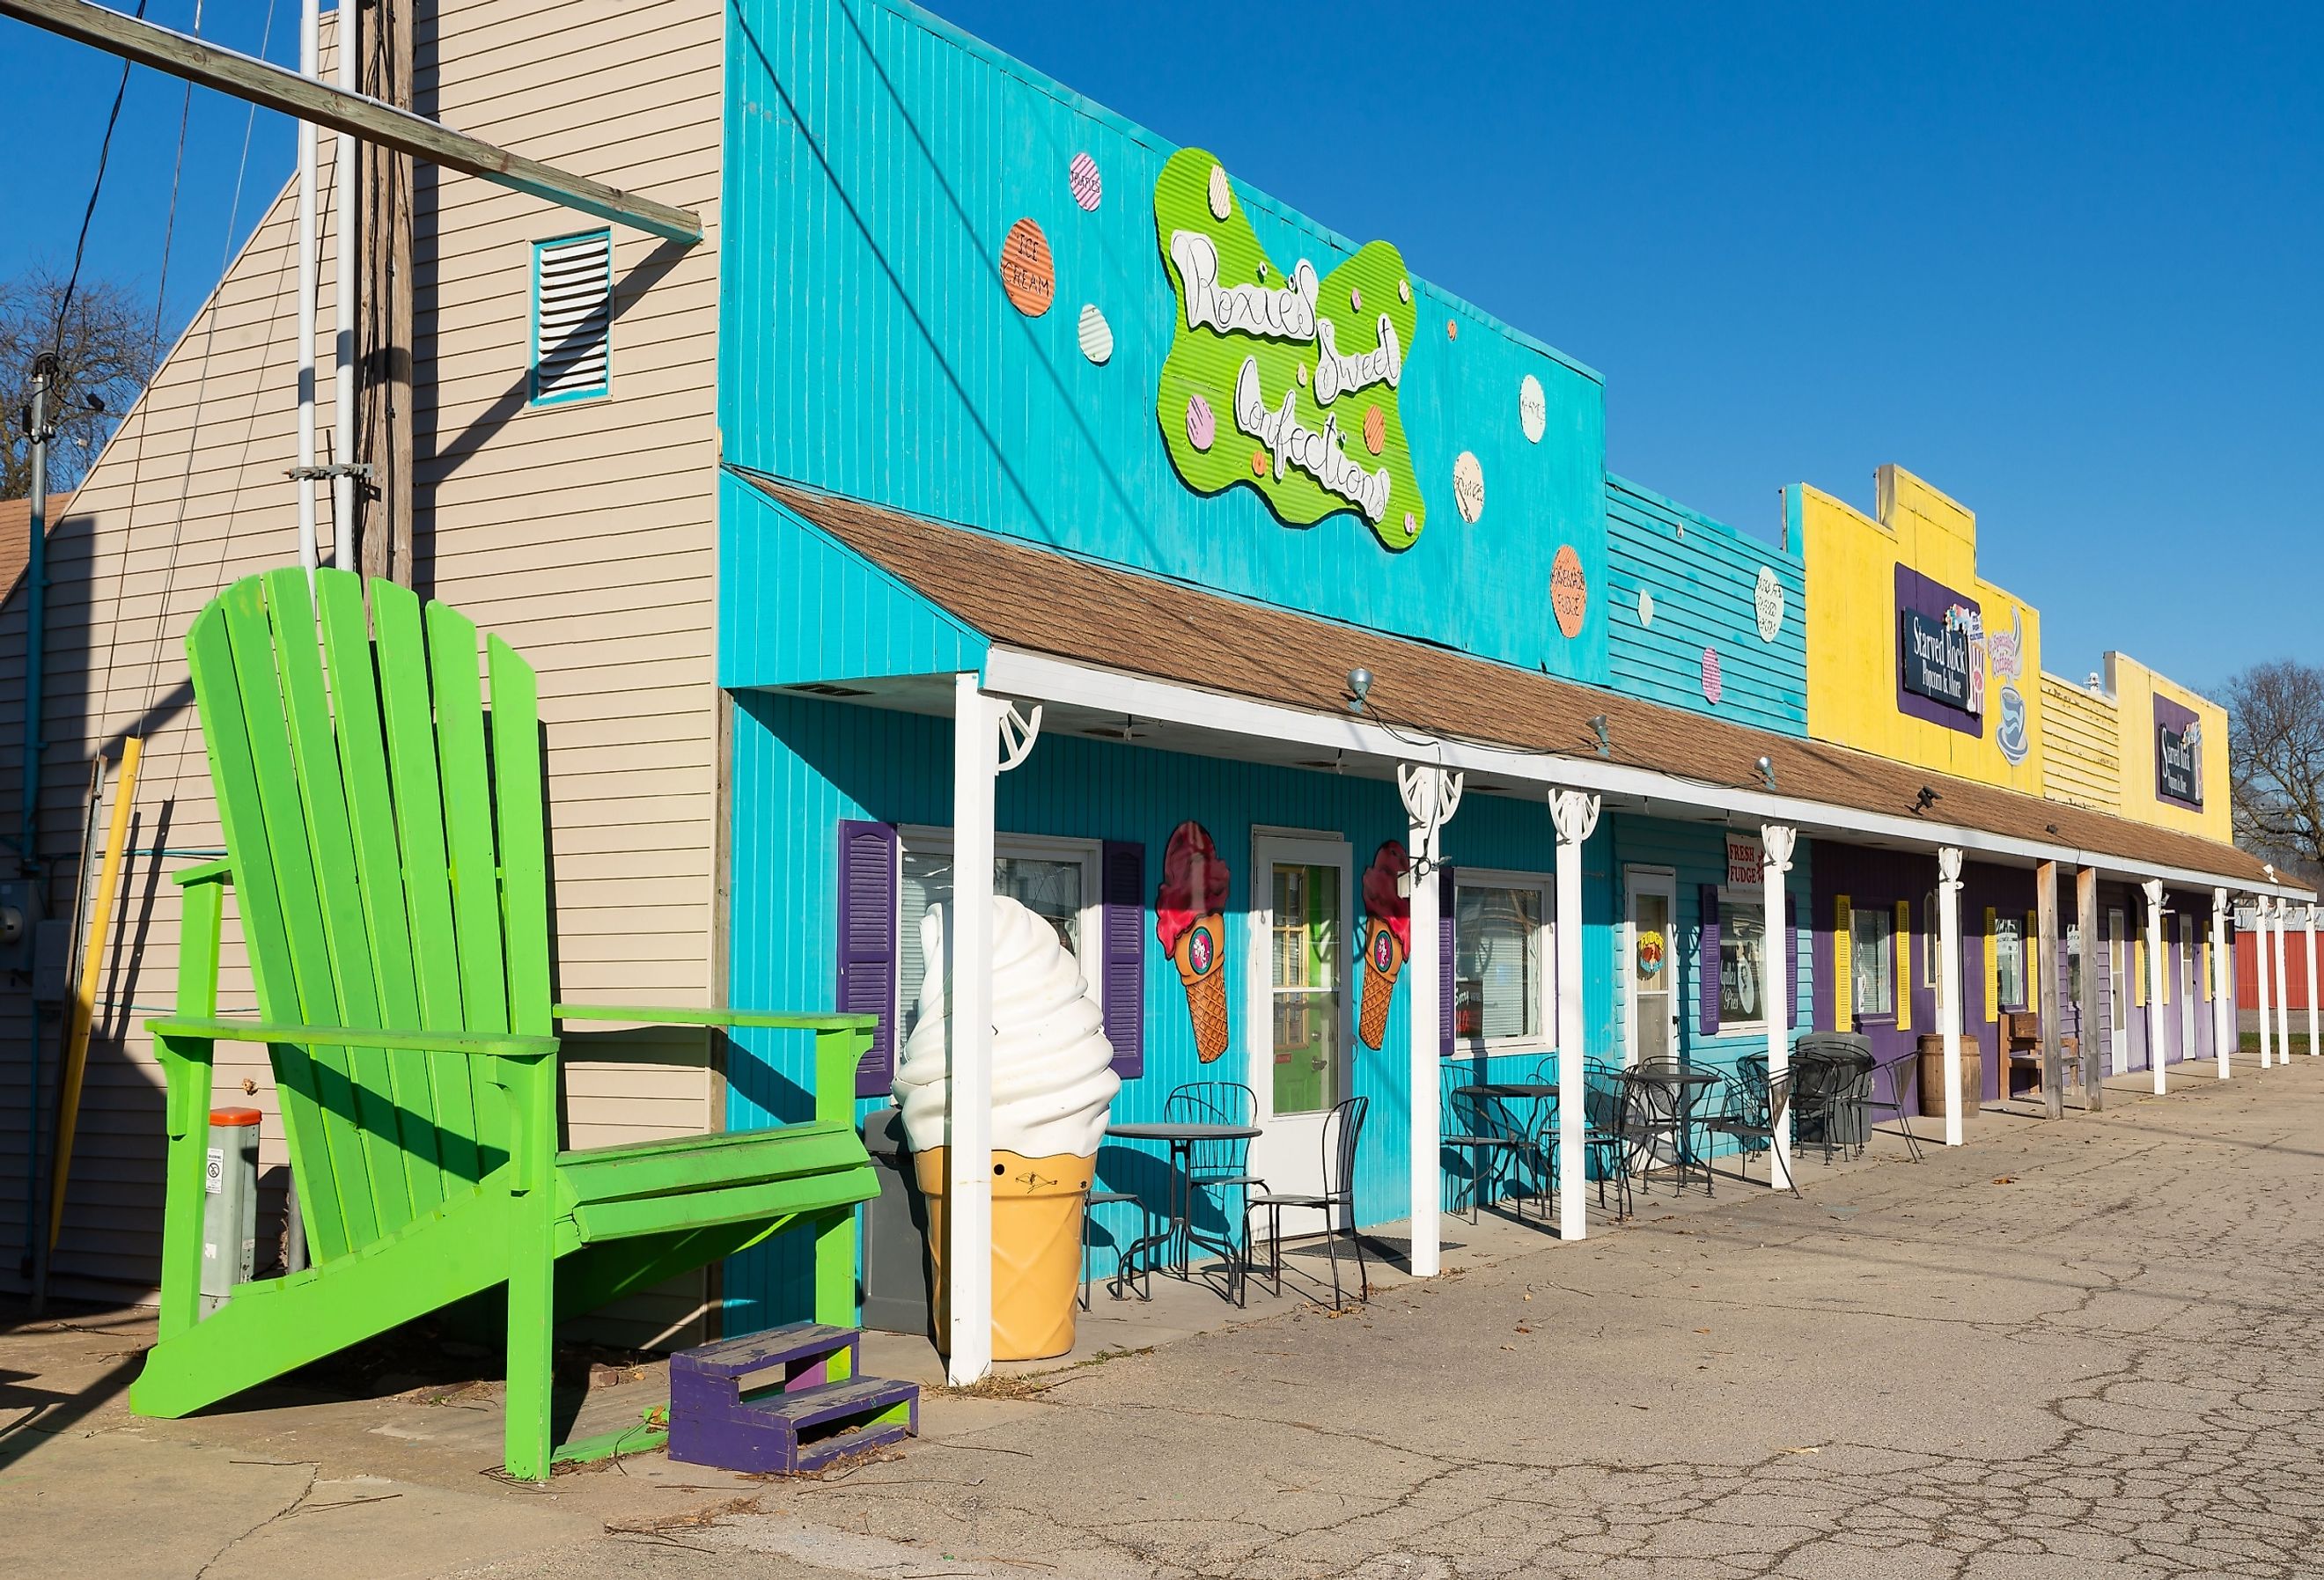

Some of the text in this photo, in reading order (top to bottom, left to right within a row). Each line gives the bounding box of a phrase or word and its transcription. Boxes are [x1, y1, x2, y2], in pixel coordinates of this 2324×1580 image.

[1019, 233, 1039, 262] ICE
[1004, 261, 1050, 297] CREAM
[1315, 316, 1401, 401] Sweet
[1238, 358, 1388, 518] Confections
[1913, 615, 1967, 675] Starved Rock
[1922, 658, 1961, 699] Popcorn & More
[1729, 844, 1755, 862] FRESH
[1730, 865, 1757, 884] FUDGE
[1640, 930, 1665, 951] FUDGE
